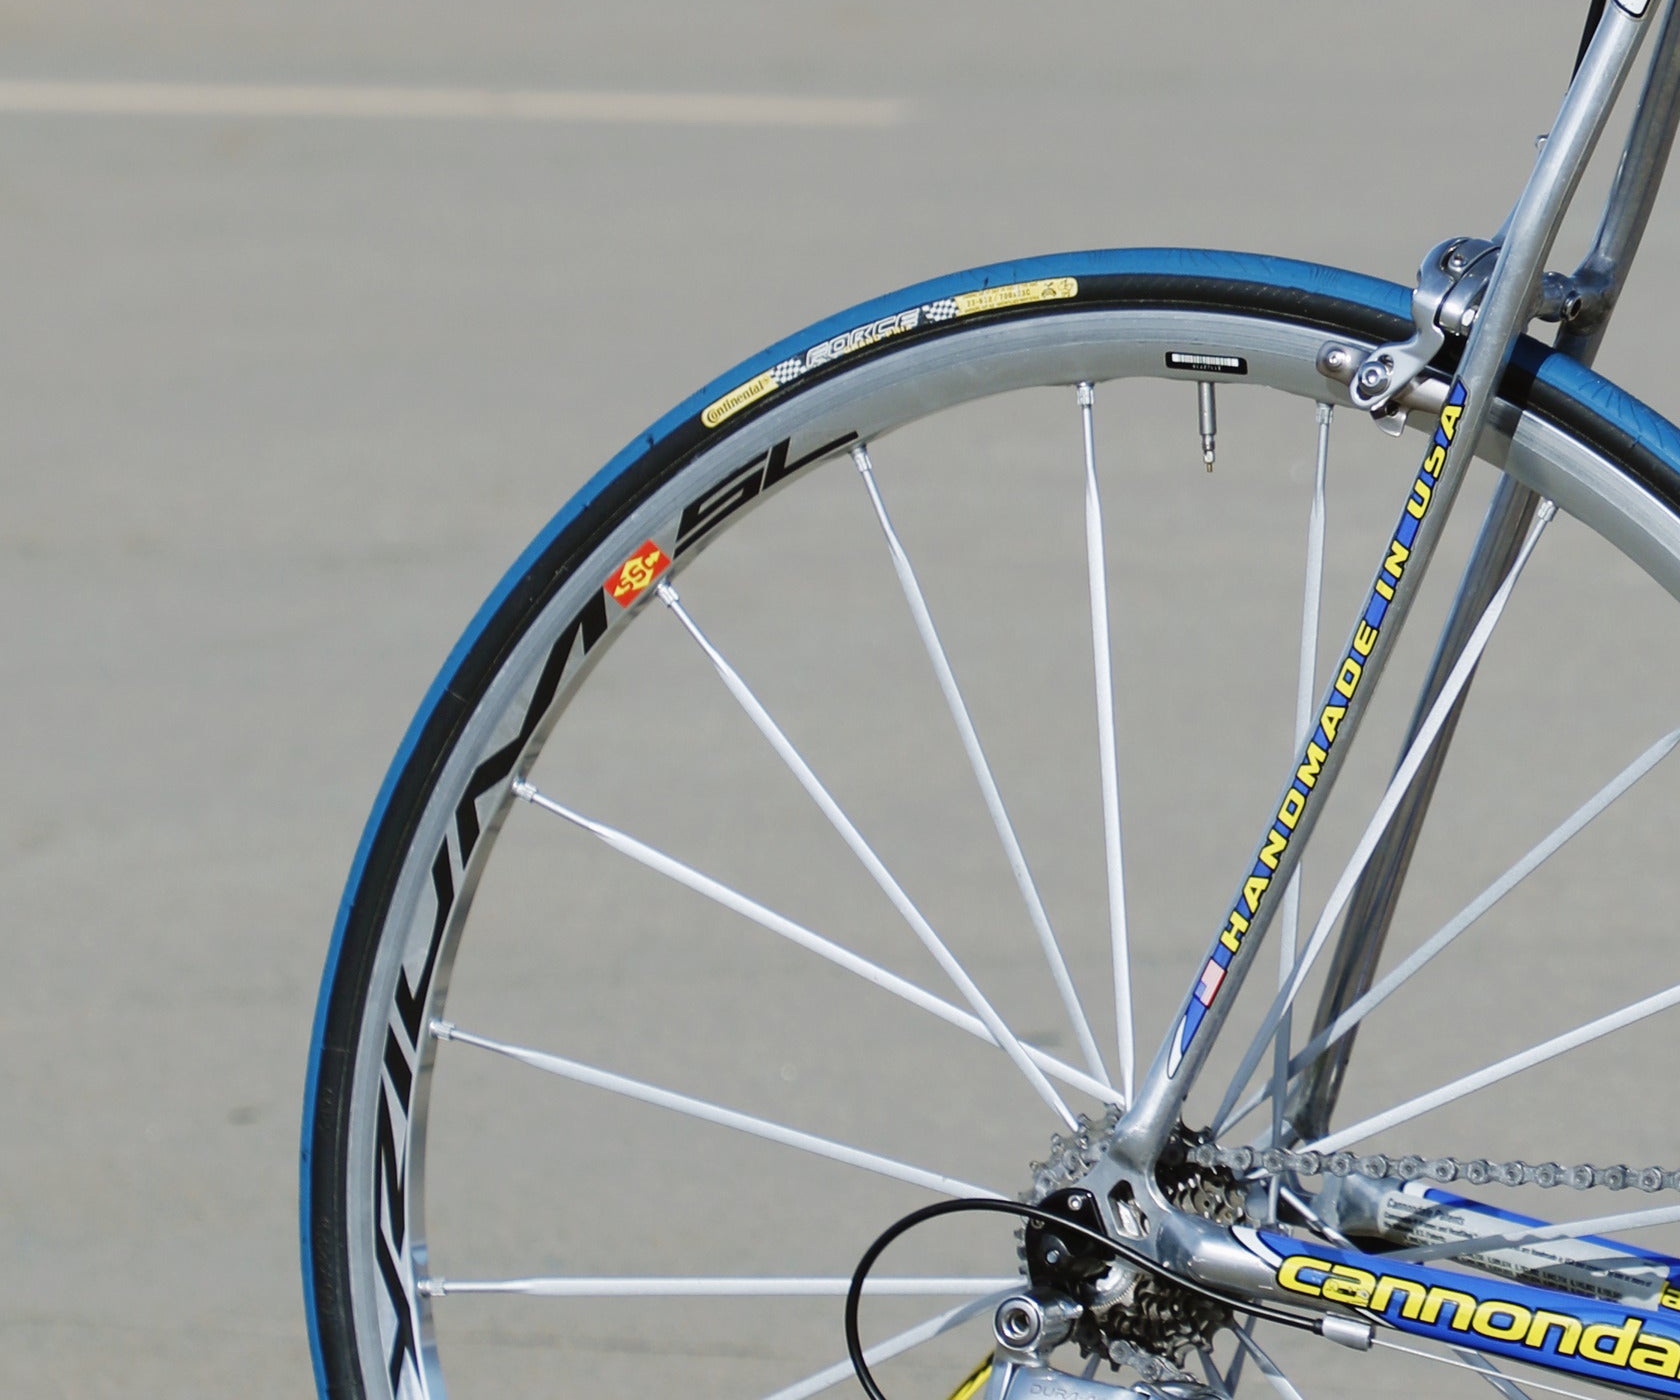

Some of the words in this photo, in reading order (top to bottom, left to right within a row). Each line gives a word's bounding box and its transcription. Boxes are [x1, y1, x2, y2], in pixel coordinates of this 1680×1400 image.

[707, 378, 766, 424] Continental
[1219, 620, 1380, 954] HANDMADE
[1374, 538, 1411, 603] IN
[1405, 400, 1466, 522] USA
